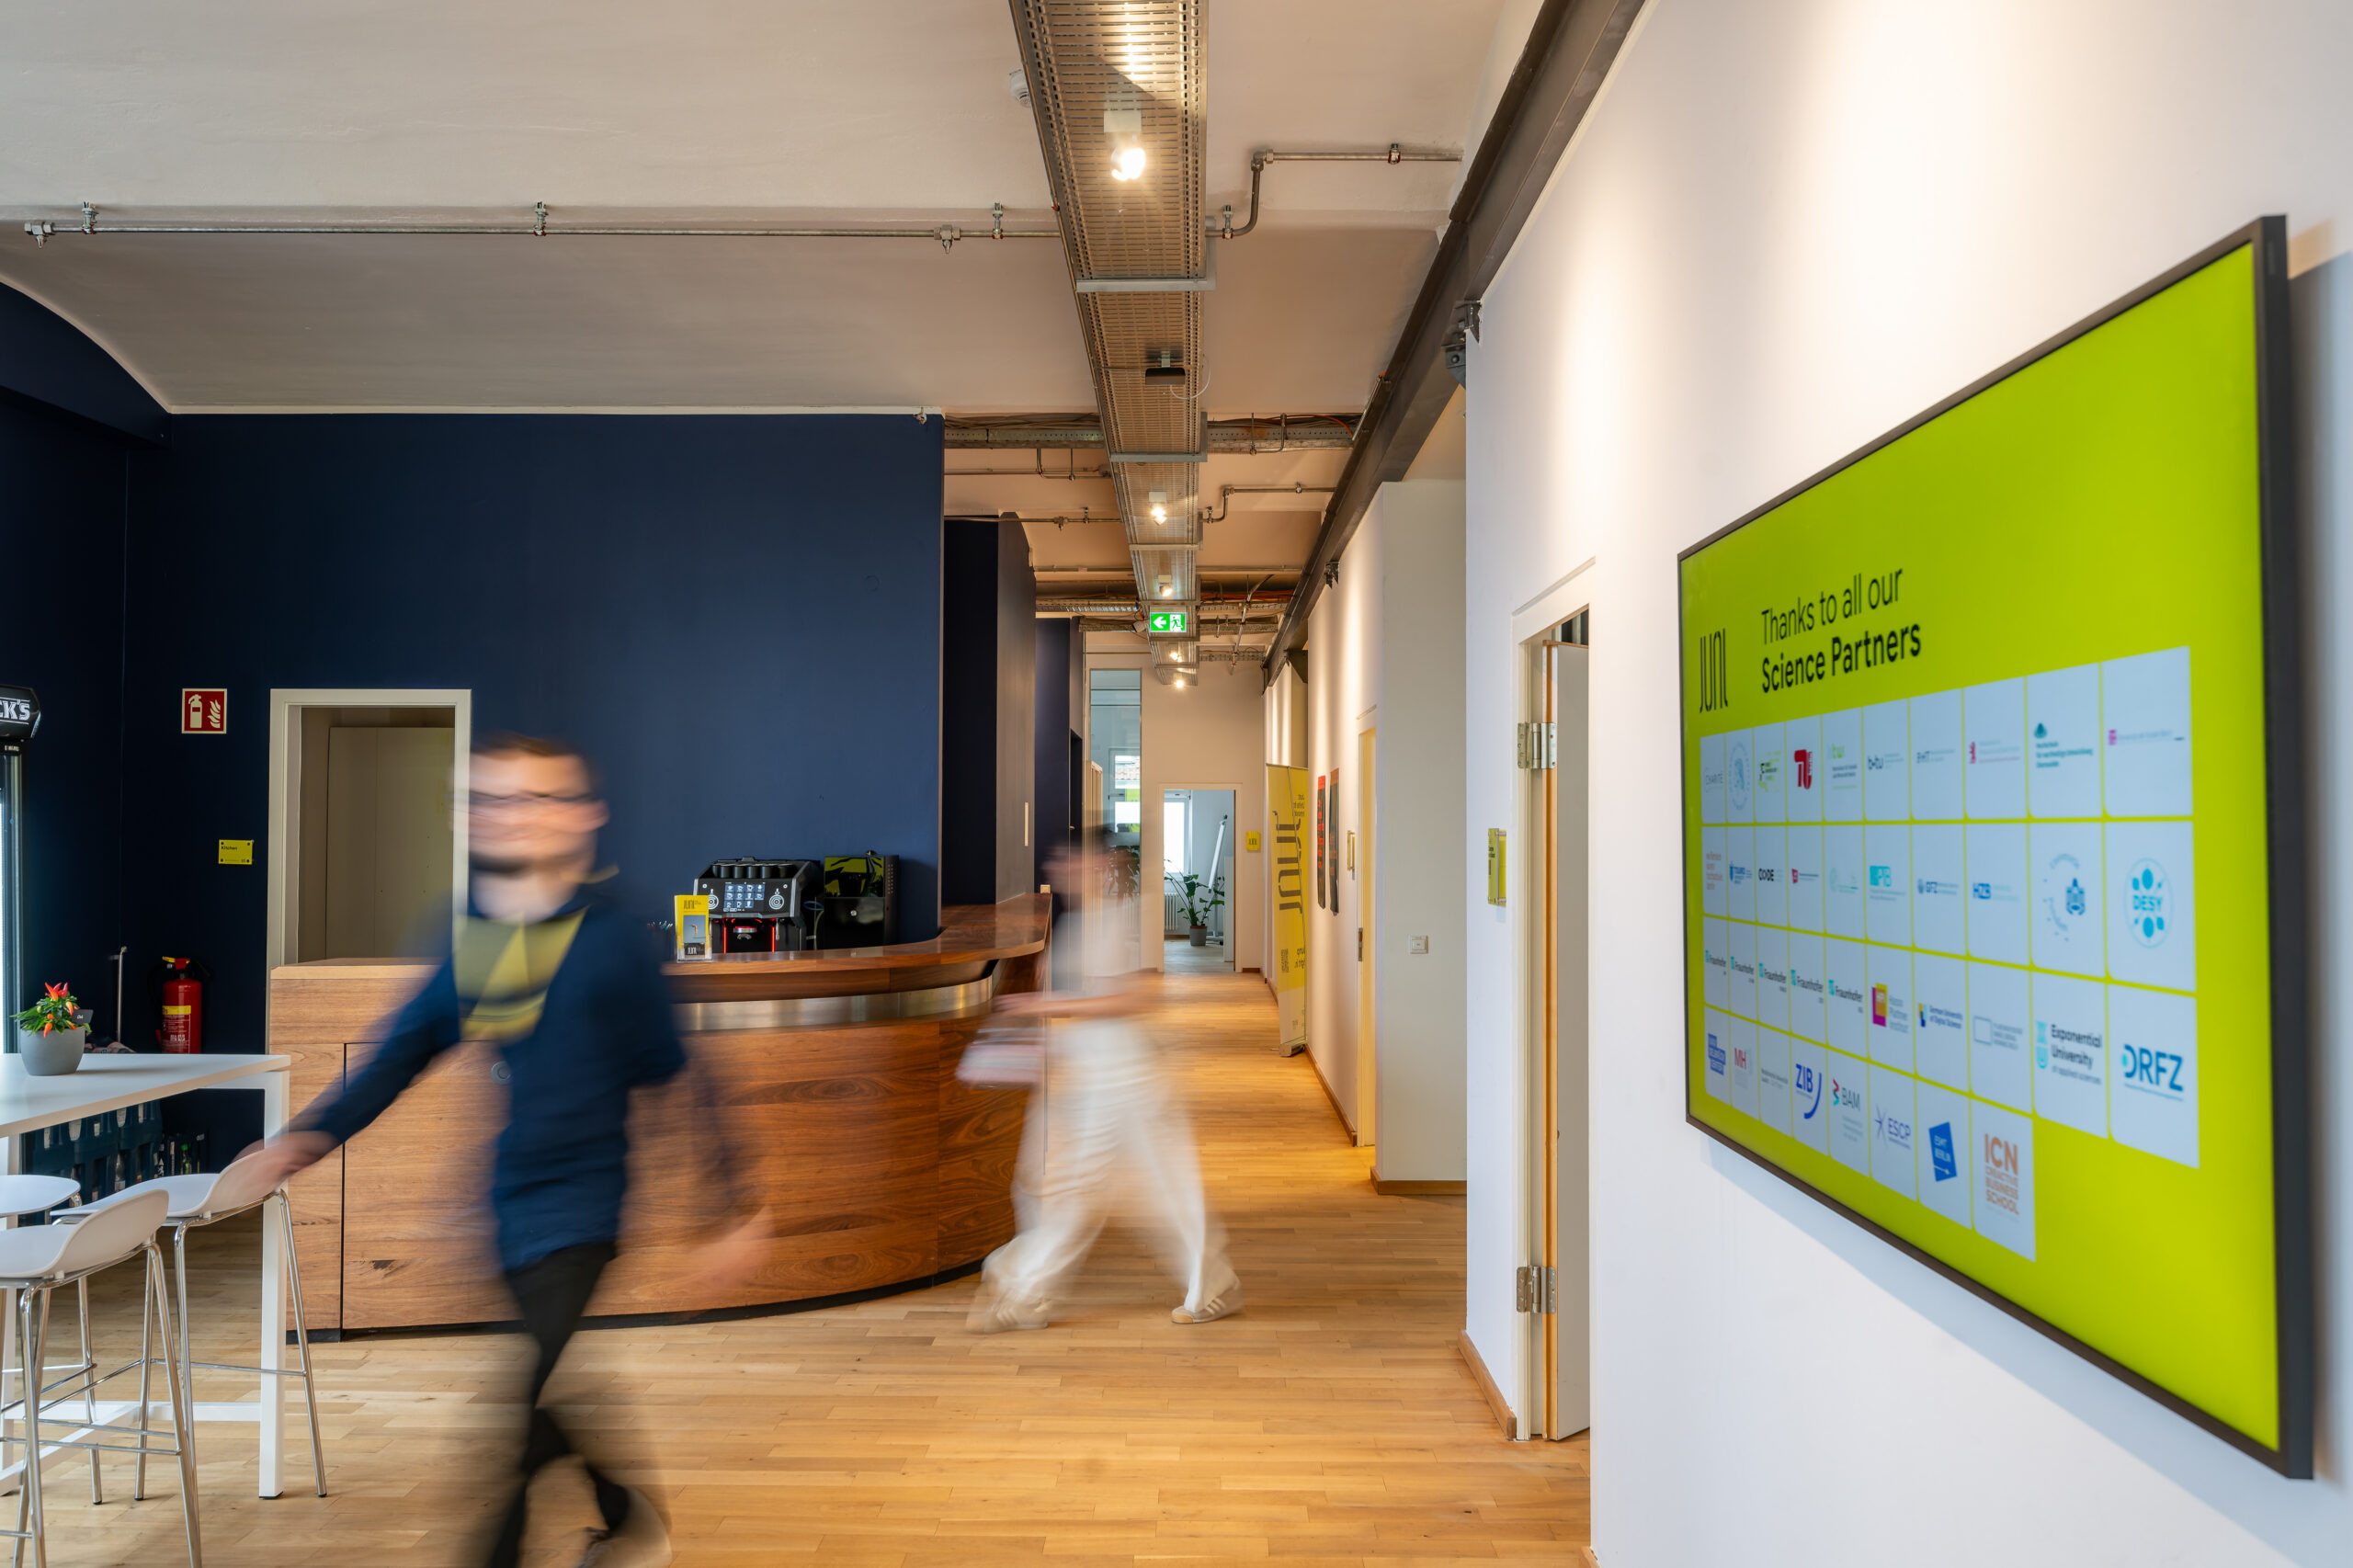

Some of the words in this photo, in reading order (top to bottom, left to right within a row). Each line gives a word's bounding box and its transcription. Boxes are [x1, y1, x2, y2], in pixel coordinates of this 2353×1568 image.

[1761, 597, 1814, 645] Thanks
[1820, 590, 1837, 626] to
[1842, 573, 1862, 619] all
[1868, 568, 1904, 609] our
[1761, 651, 1825, 694] Science
[1831, 623, 1922, 676] Partners
[1758, 868, 1775, 882] CODE
[2132, 894, 2163, 913] DESY
[1835, 984, 1863, 1004] Fraunhofer
[2051, 1023, 2102, 1049] Exponential
[2051, 1046, 2094, 1070] University
[2120, 1043, 2185, 1092] DRFZ
[1795, 1062, 1813, 1094] ZIB
[1841, 1086, 1861, 1111] BAM
[1887, 1117, 1912, 1139] ESCP
[1984, 1132, 2019, 1176] ICN
[1985, 1177, 2019, 1200] BUSINESS
[1985, 1188, 2020, 1215] SCHOOL
